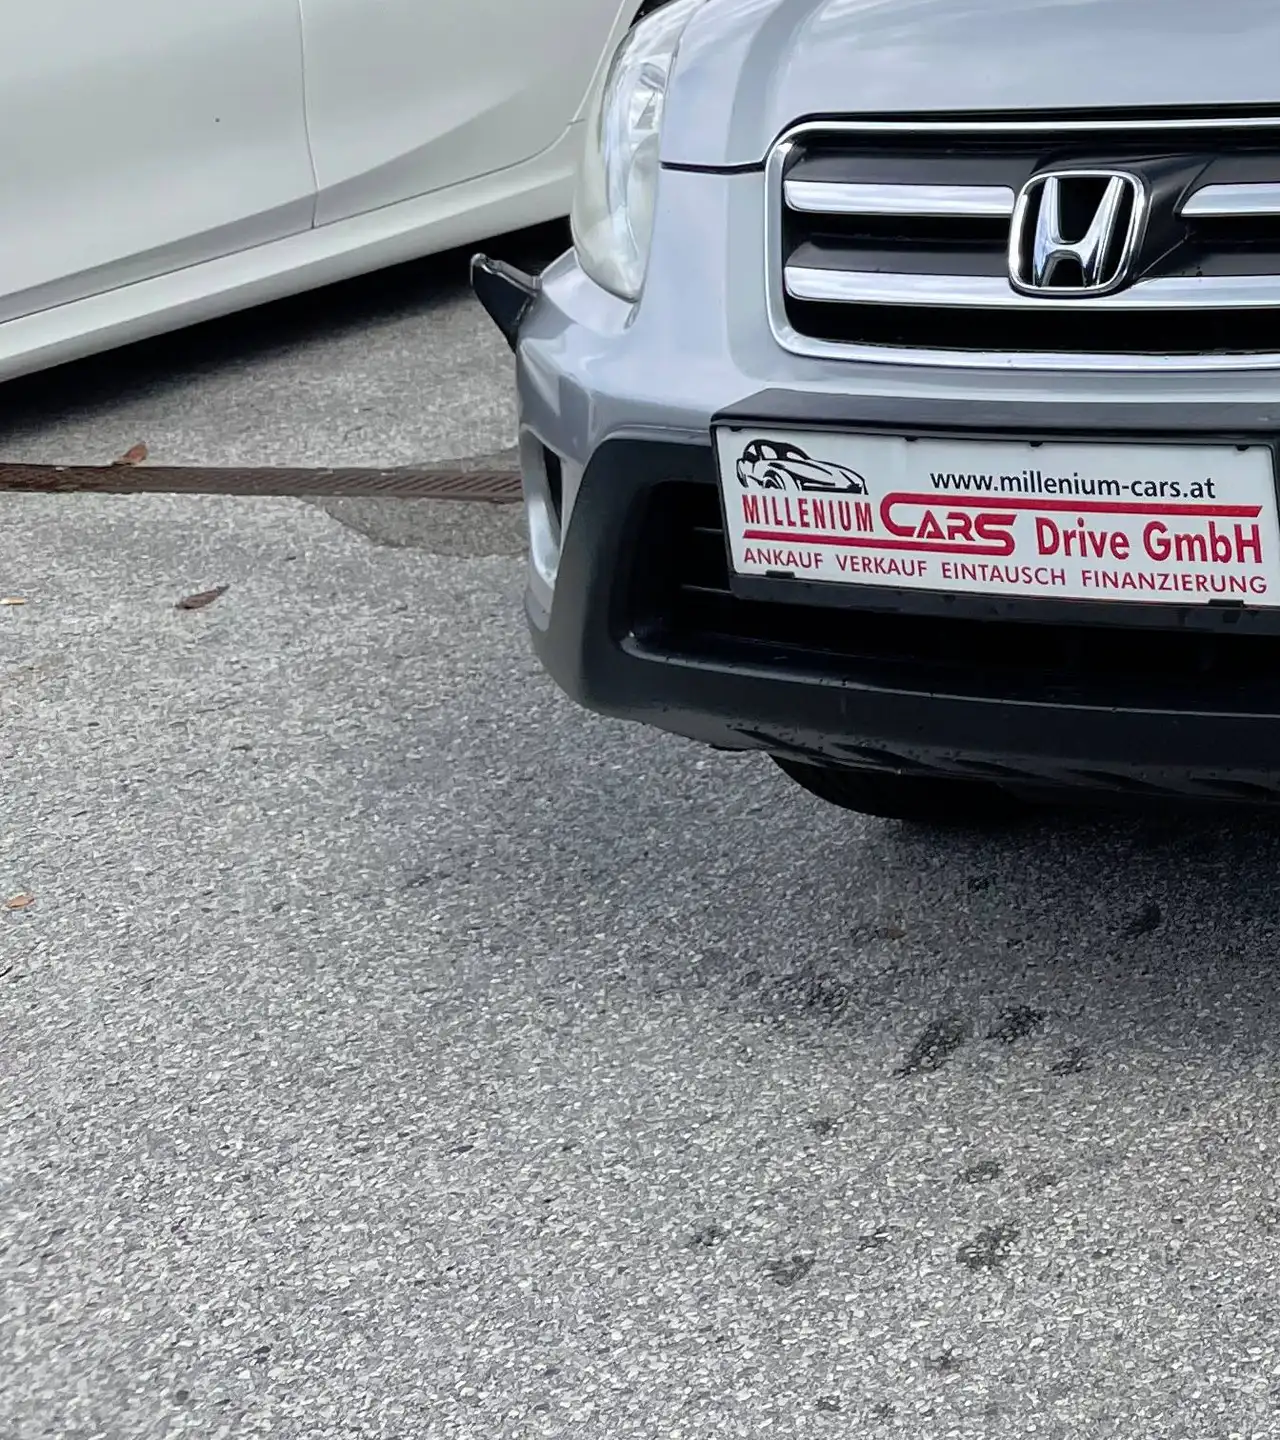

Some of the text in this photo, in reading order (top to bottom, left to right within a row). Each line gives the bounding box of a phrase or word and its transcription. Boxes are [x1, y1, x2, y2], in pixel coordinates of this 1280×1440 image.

[929, 470, 1216, 499] www.millenium-cars.at
[742, 494, 874, 533] MILLENIUM
[1035, 516, 1131, 561] Drive
[1142, 519, 1264, 565] GmbH
[743, 547, 1268, 596] ANKAUF VERKAUF EINTAUSCH FINANZIERUNG
